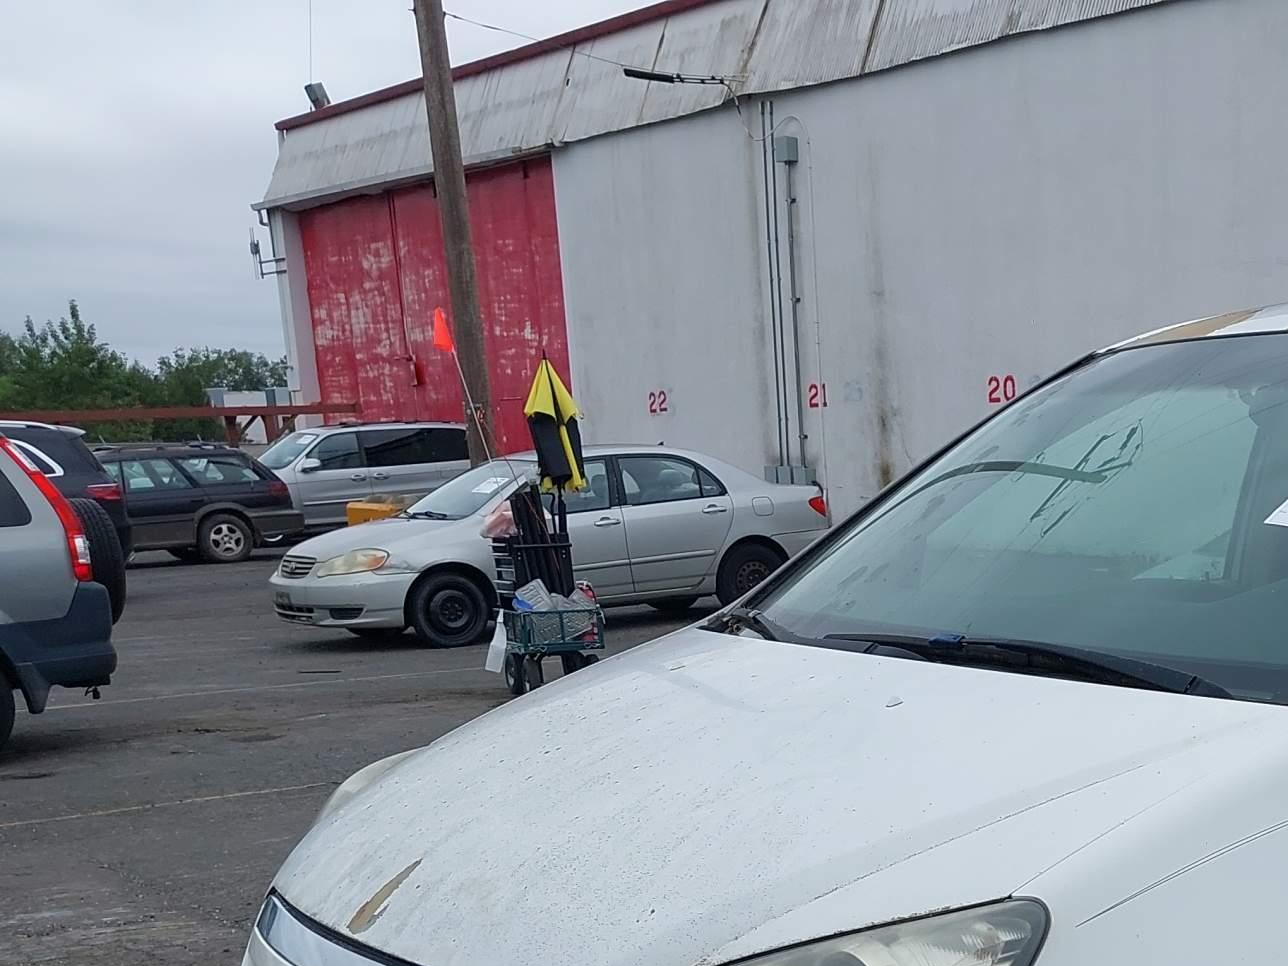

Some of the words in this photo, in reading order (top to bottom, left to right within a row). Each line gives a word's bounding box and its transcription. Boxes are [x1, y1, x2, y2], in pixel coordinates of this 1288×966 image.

[648, 390, 668, 414] 22
[808, 383, 828, 409] 21
[987, 374, 1017, 404] 20
